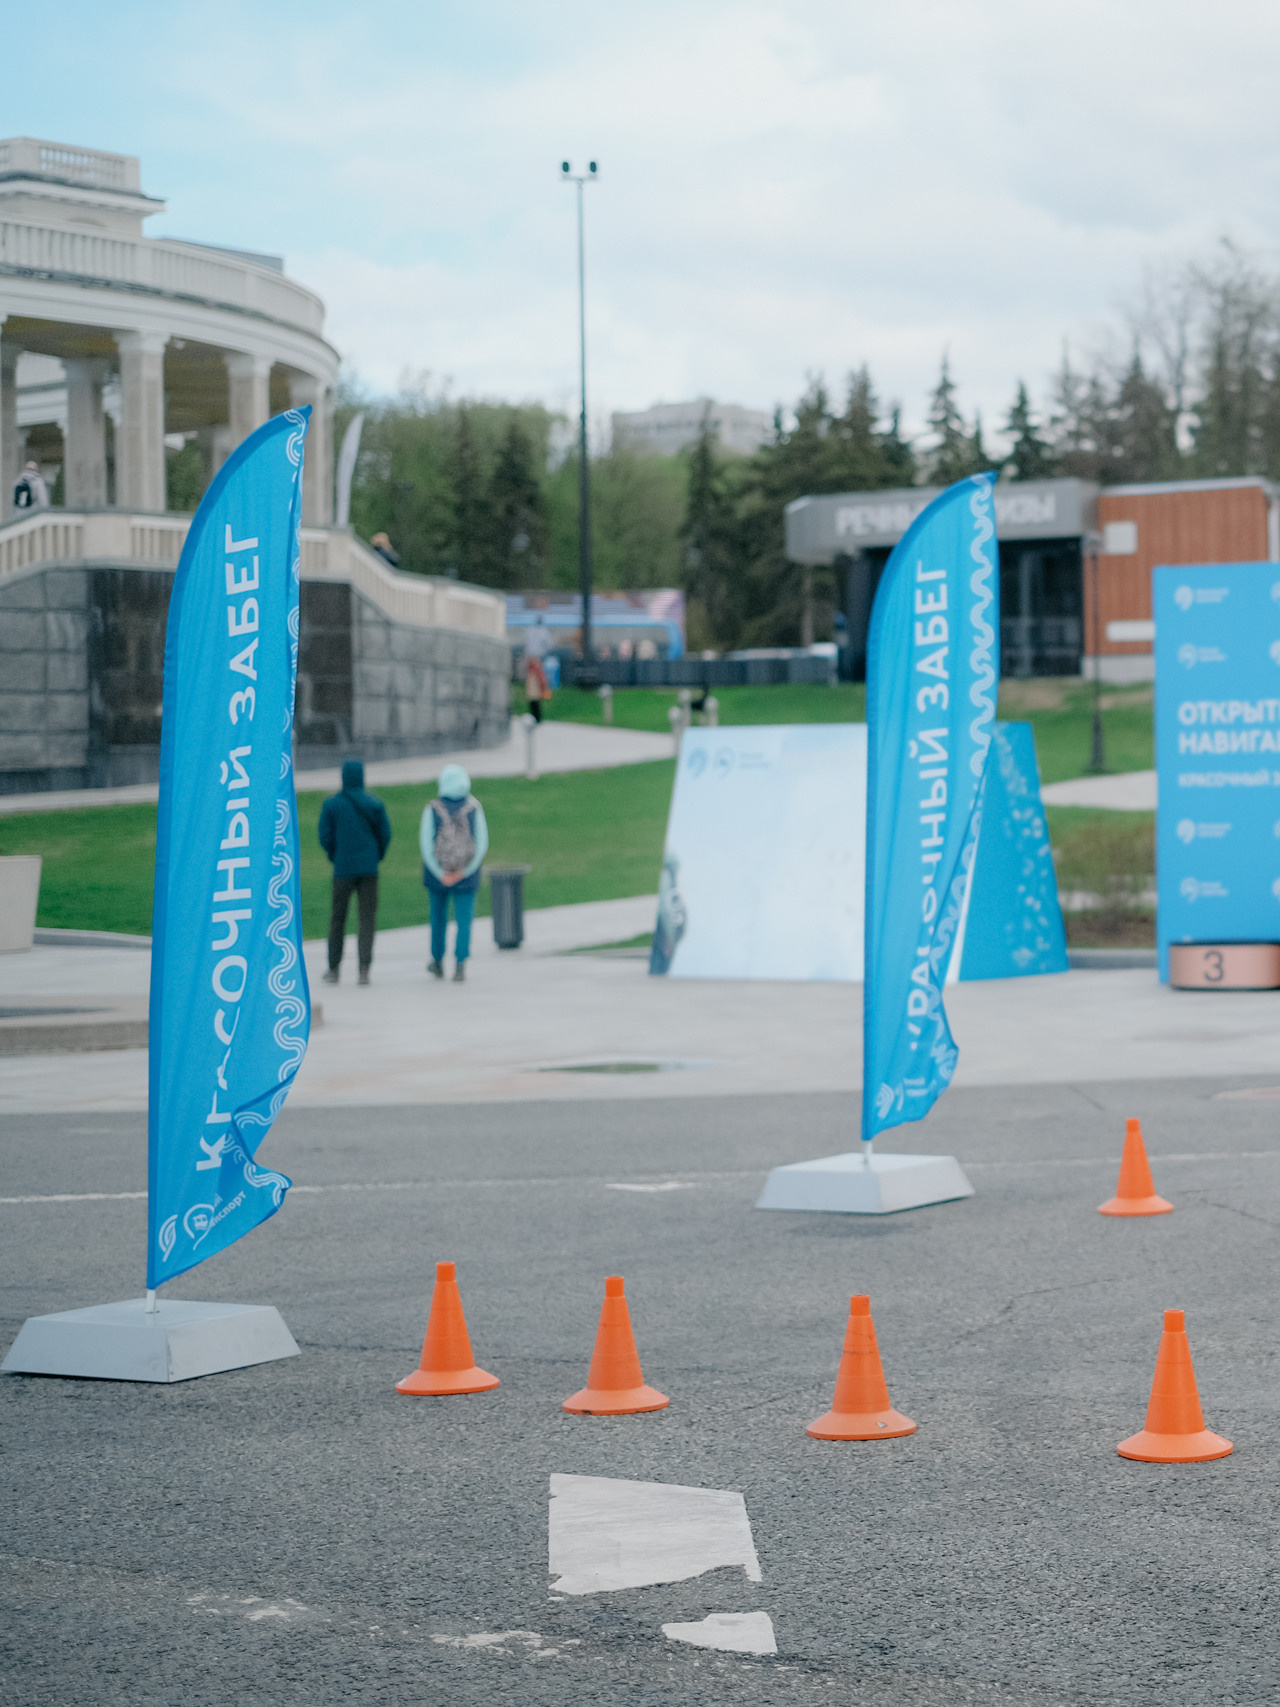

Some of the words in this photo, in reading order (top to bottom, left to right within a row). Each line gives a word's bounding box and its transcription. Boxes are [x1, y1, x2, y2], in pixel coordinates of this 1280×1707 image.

[224, 524, 260, 726] ЗАБЕГ
[914, 560, 950, 713] ЗАБЕГ
[1203, 950, 1226, 983] 3
